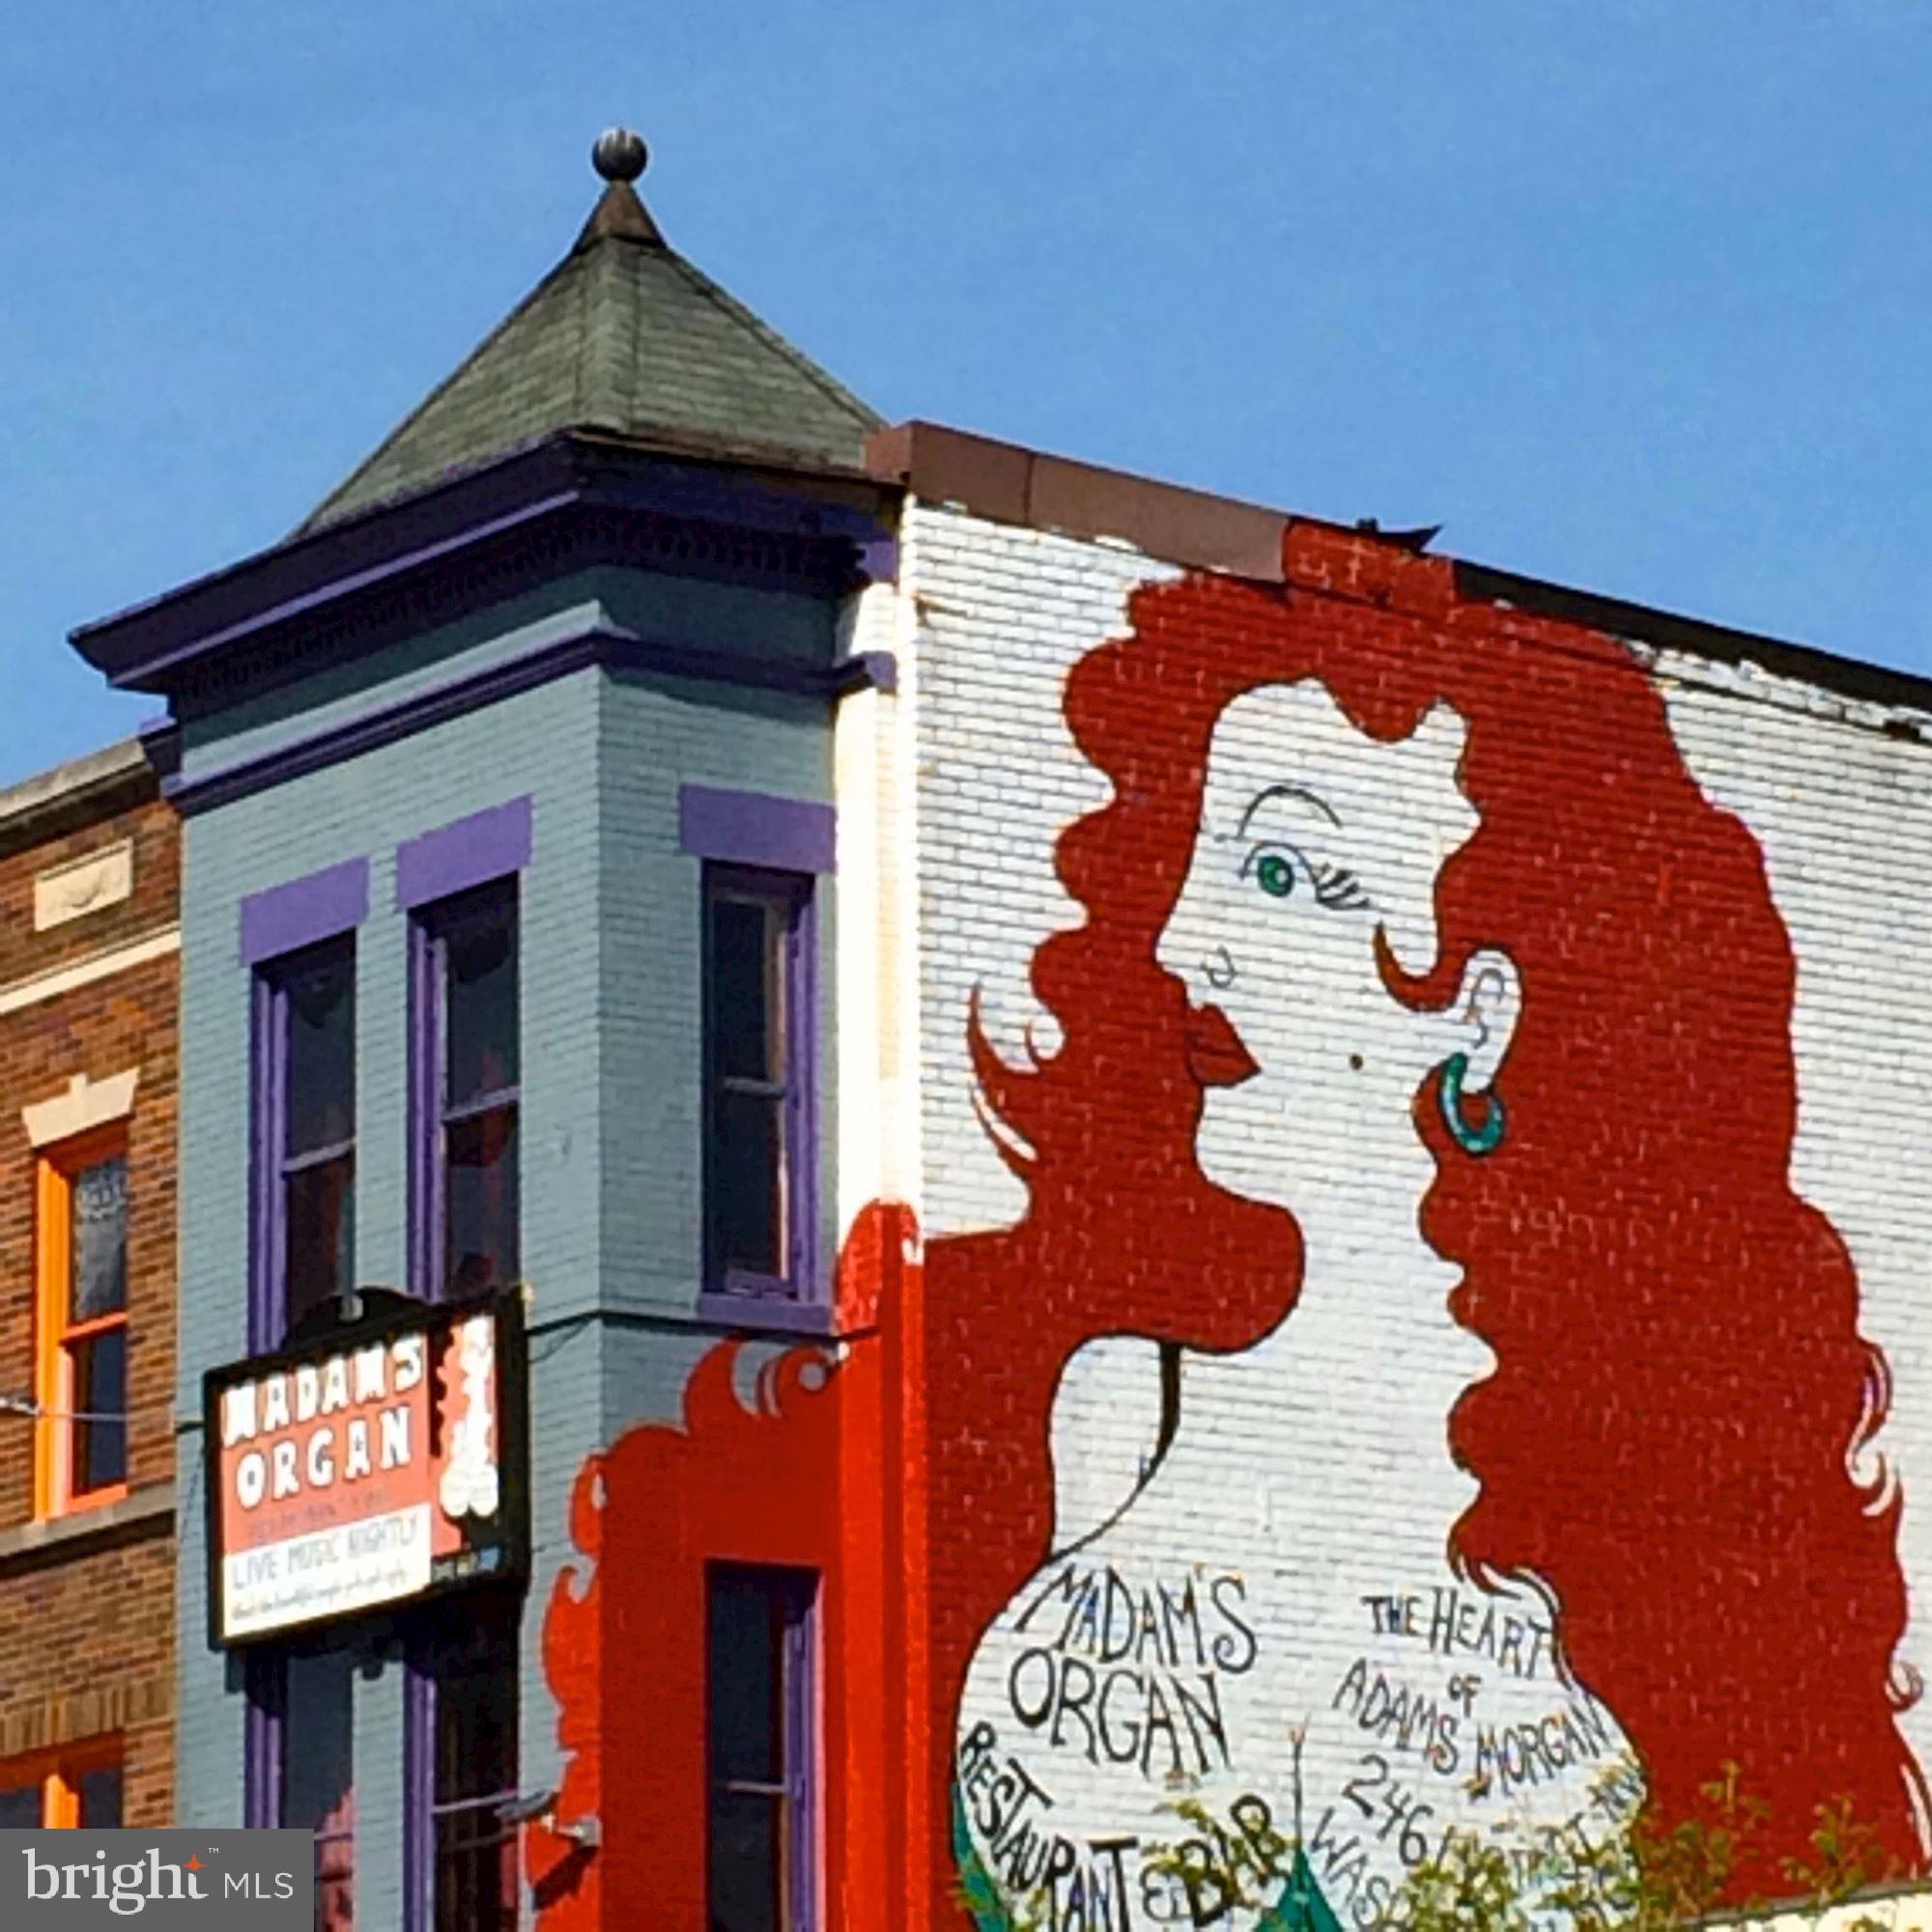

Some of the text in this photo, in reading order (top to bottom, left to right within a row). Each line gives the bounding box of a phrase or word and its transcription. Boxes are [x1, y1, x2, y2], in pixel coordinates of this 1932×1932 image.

[236, 1406, 411, 1509] ORGAN
[233, 1550, 278, 1590] LIVE
[1014, 1562, 1256, 1674] MADAM'S
[1360, 1585, 1552, 1681] THE HEART
[1009, 1647, 1233, 1781] ORGAN
[1331, 1656, 1611, 1799] ADAMS MORGAN
[1448, 1673, 1482, 1719] OF
